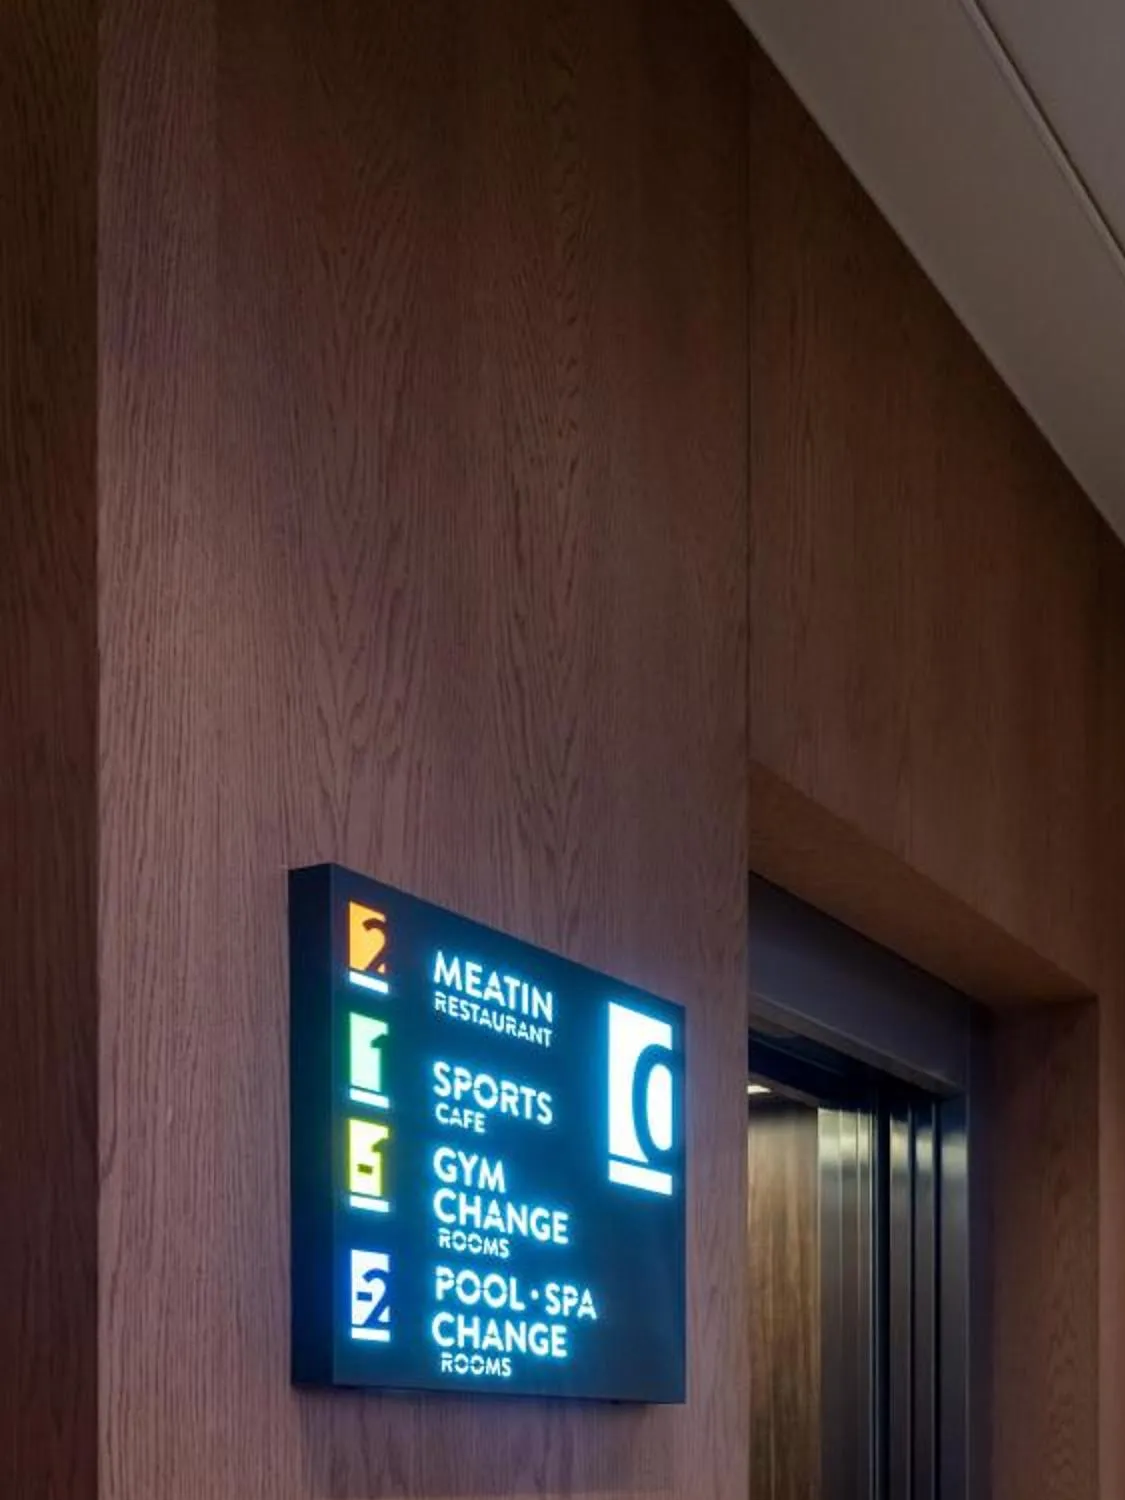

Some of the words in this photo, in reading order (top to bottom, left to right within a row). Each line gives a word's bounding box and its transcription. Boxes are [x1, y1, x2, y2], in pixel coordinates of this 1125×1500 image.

[363, 917, 389, 976] 2
[433, 950, 553, 1024] MEATIN
[434, 991, 553, 1048] RESTAURANT
[433, 1061, 553, 1125] SPORTS
[435, 1102, 487, 1134] CAFE
[433, 1147, 506, 1193] GYM
[433, 1188, 569, 1244] CHANGE
[438, 1227, 510, 1259] ROOMS
[432, 1312, 567, 1358] CHANGE
[441, 1352, 512, 1378] ROOMS
